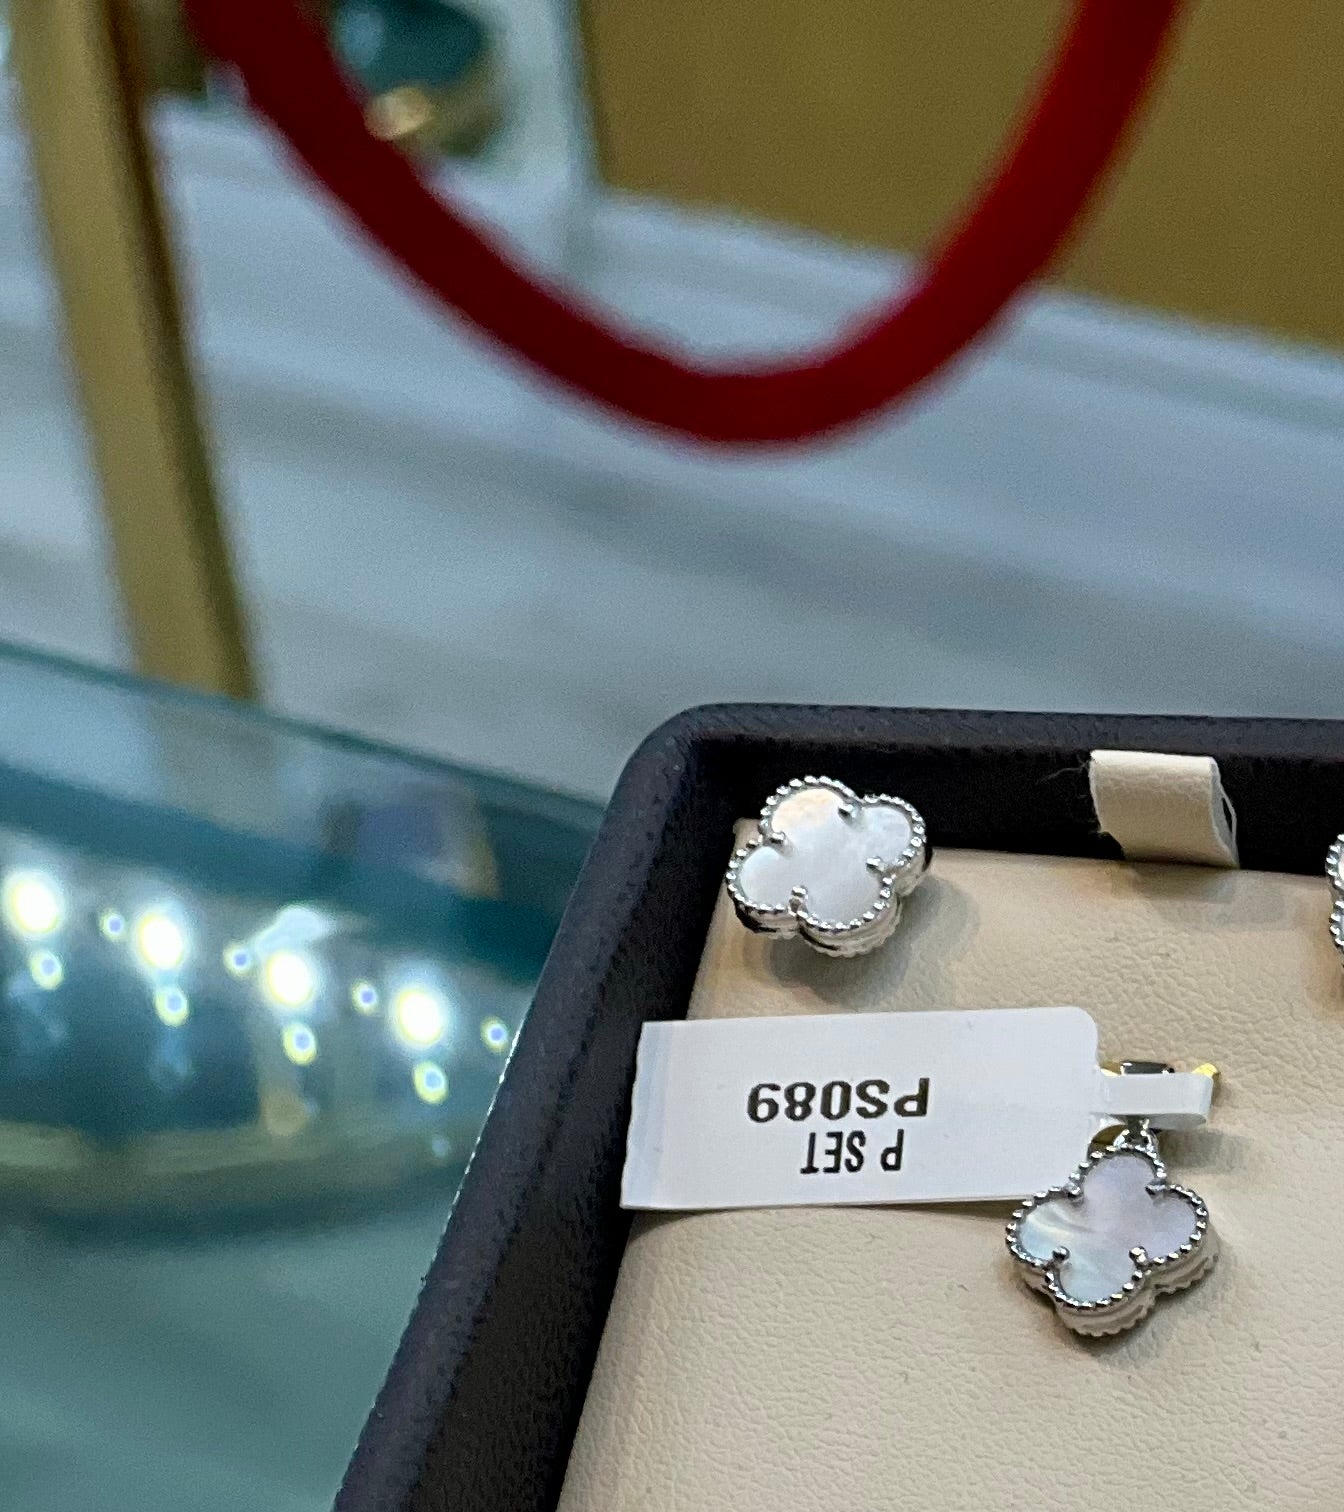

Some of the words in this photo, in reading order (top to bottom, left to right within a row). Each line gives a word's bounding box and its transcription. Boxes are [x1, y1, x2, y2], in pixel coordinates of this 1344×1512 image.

[746, 1077, 930, 1123] PS089
[799, 1130, 866, 1174] SET
[880, 1128, 904, 1171] P
